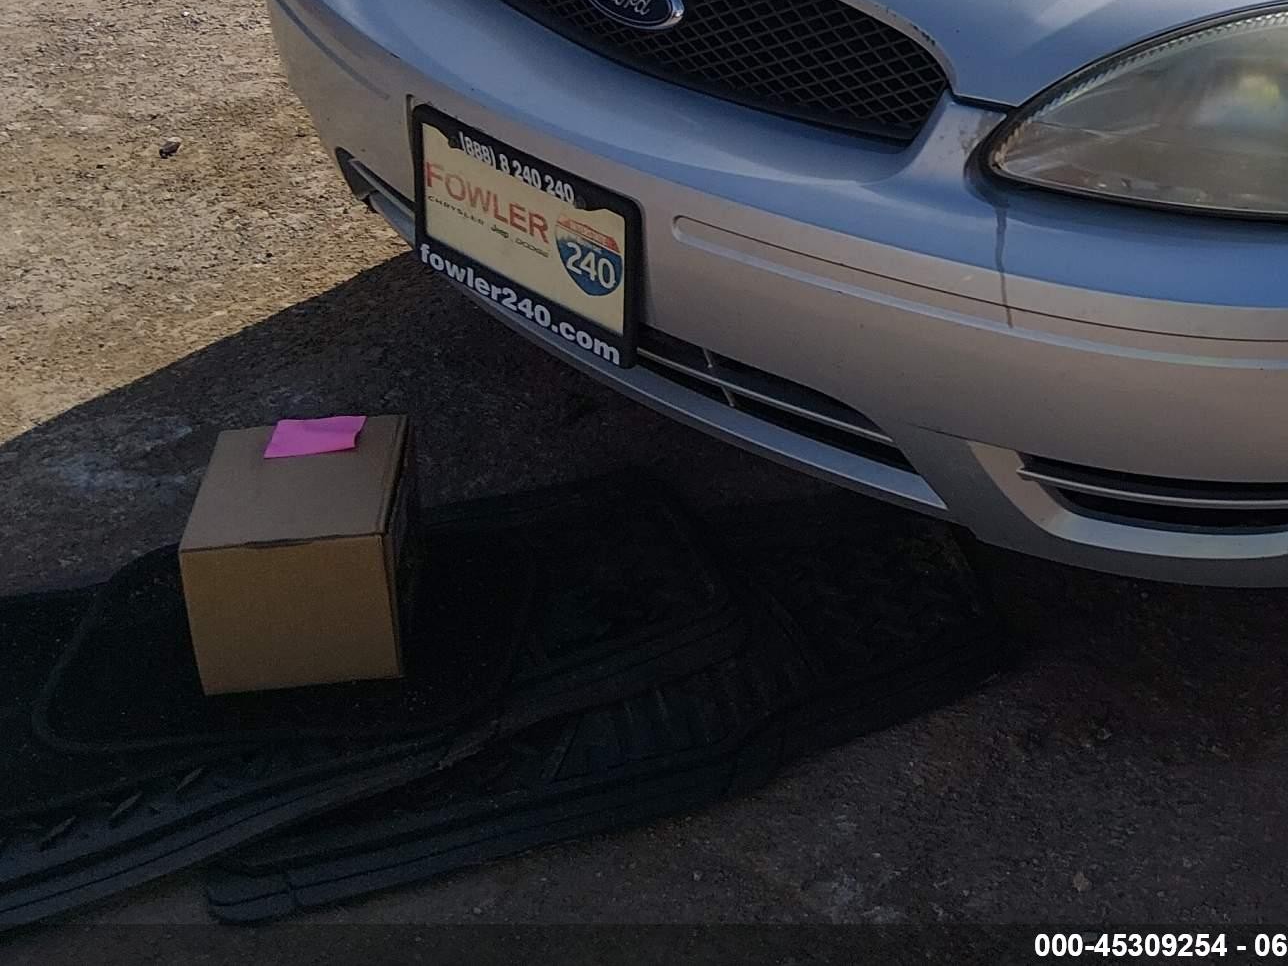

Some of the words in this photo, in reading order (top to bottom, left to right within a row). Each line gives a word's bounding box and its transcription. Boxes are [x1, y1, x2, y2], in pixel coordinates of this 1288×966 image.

[425, 161, 551, 244] FOWLER
[458, 131, 497, 167] (888)
[498, 153, 511, 175] 8
[512, 160, 542, 190] 240
[544, 174, 576, 205] 240
[420, 243, 620, 366] fowler240.com
[566, 241, 617, 290] 240
